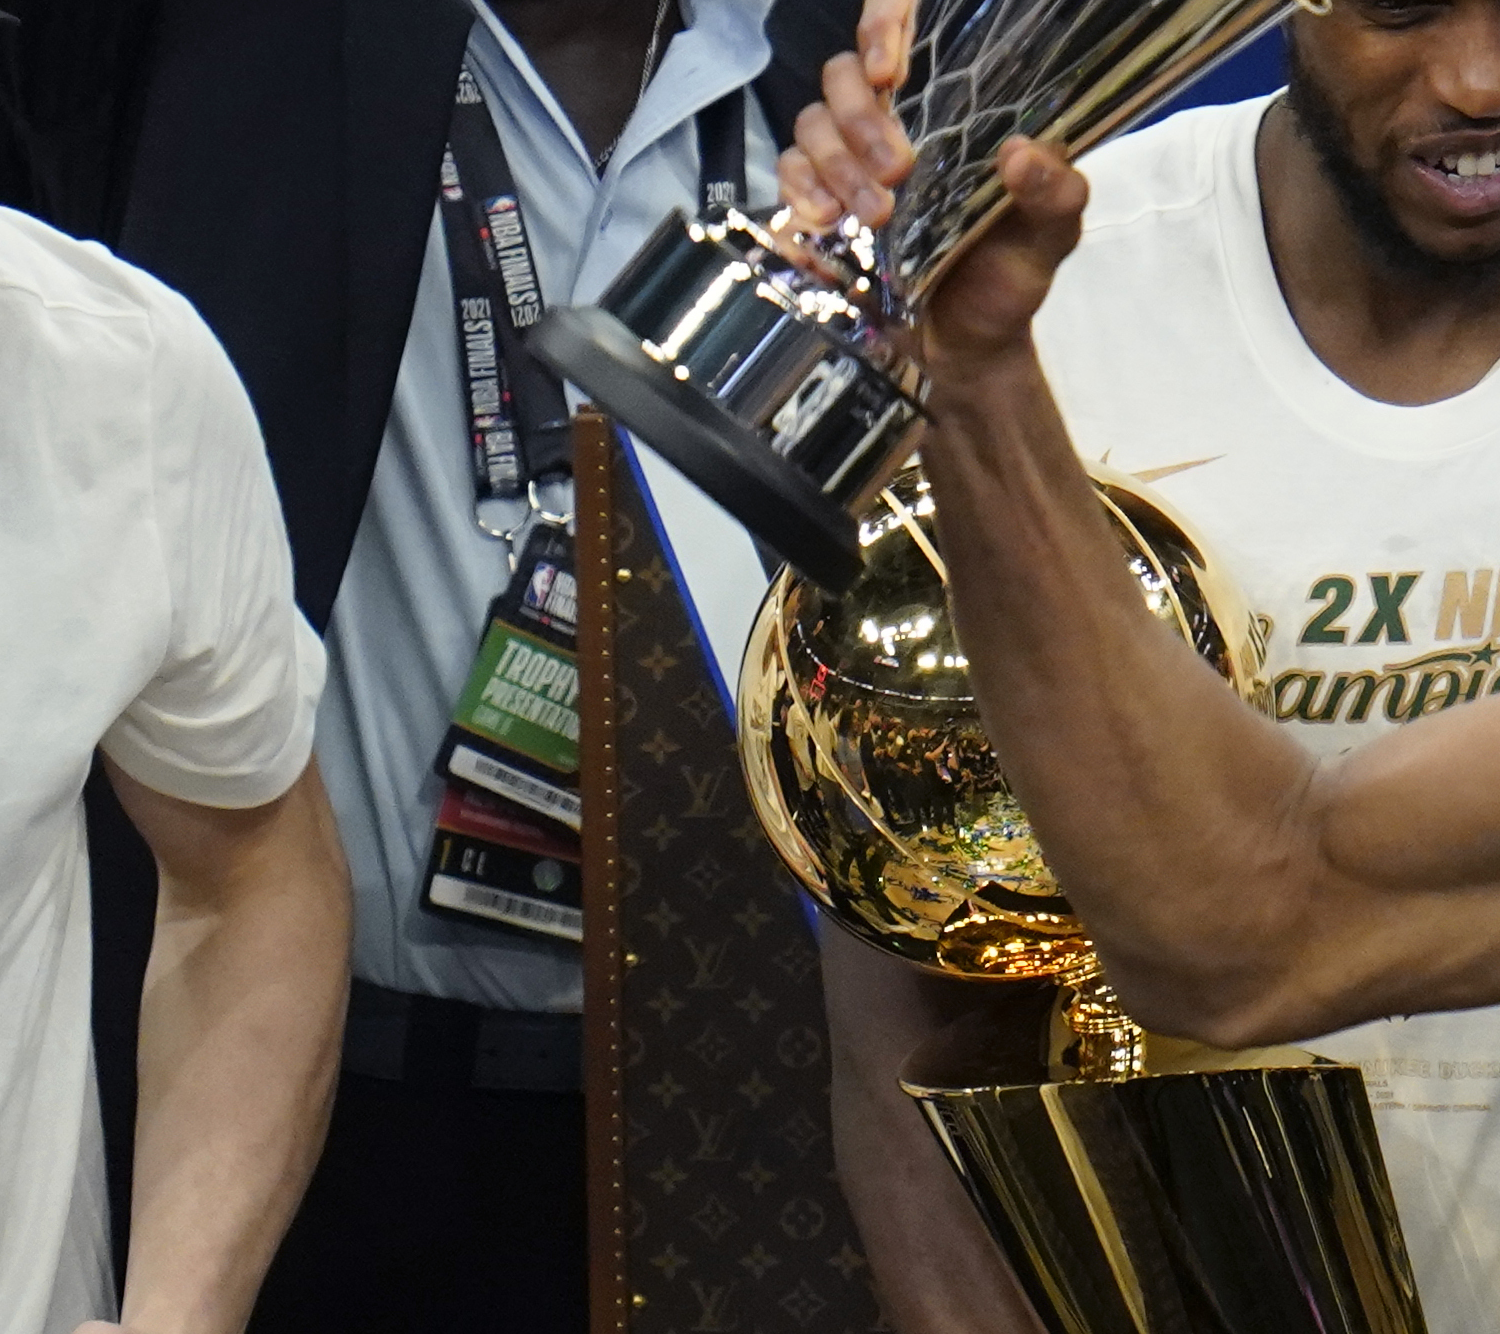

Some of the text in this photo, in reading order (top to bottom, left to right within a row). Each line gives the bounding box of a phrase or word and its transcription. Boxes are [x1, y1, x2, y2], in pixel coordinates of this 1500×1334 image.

[461, 297, 492, 319] 2021
[465, 318, 499, 379] FINALS
[1296, 571, 1425, 647] 2X
